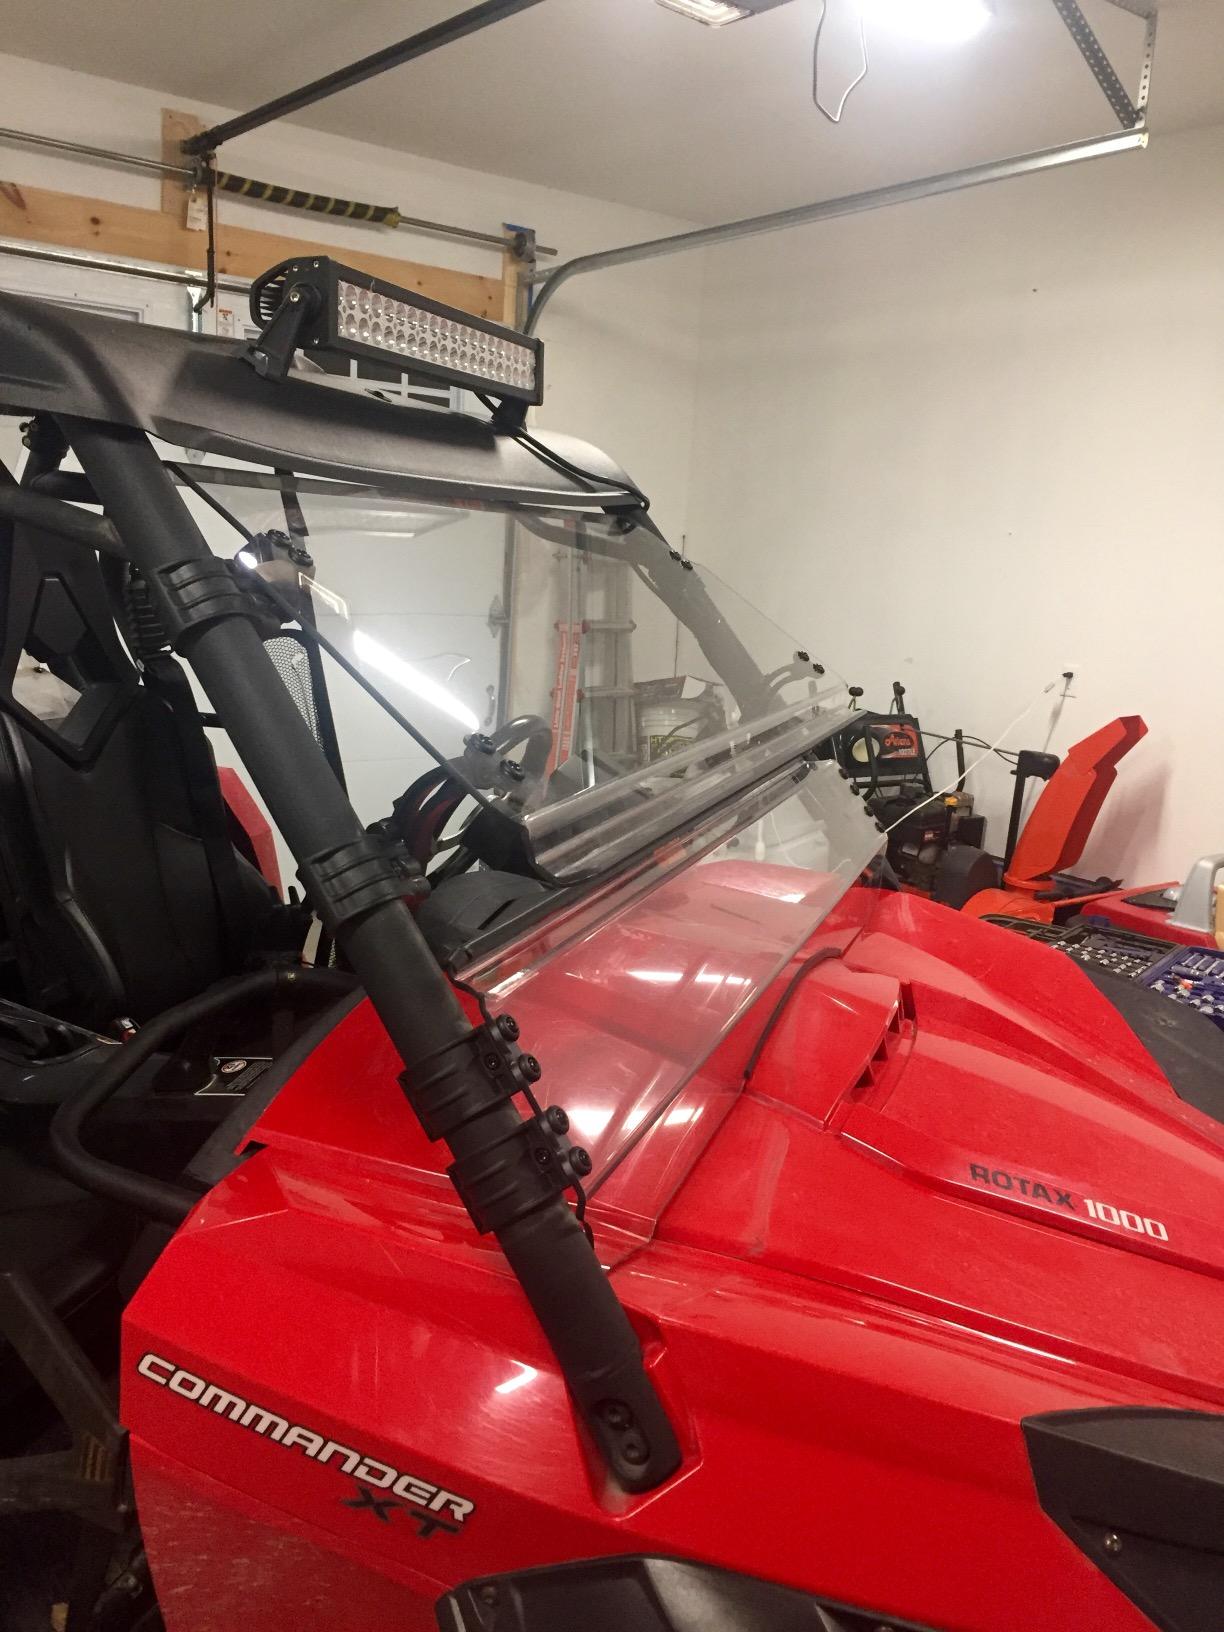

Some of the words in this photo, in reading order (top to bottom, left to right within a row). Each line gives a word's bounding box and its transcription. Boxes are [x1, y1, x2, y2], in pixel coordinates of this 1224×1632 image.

[969, 1163, 1076, 1211] ROTAX
[1083, 1198, 1169, 1242] 1000
[137, 1352, 475, 1523] COMMANDER
[342, 1485, 461, 1540] XT
